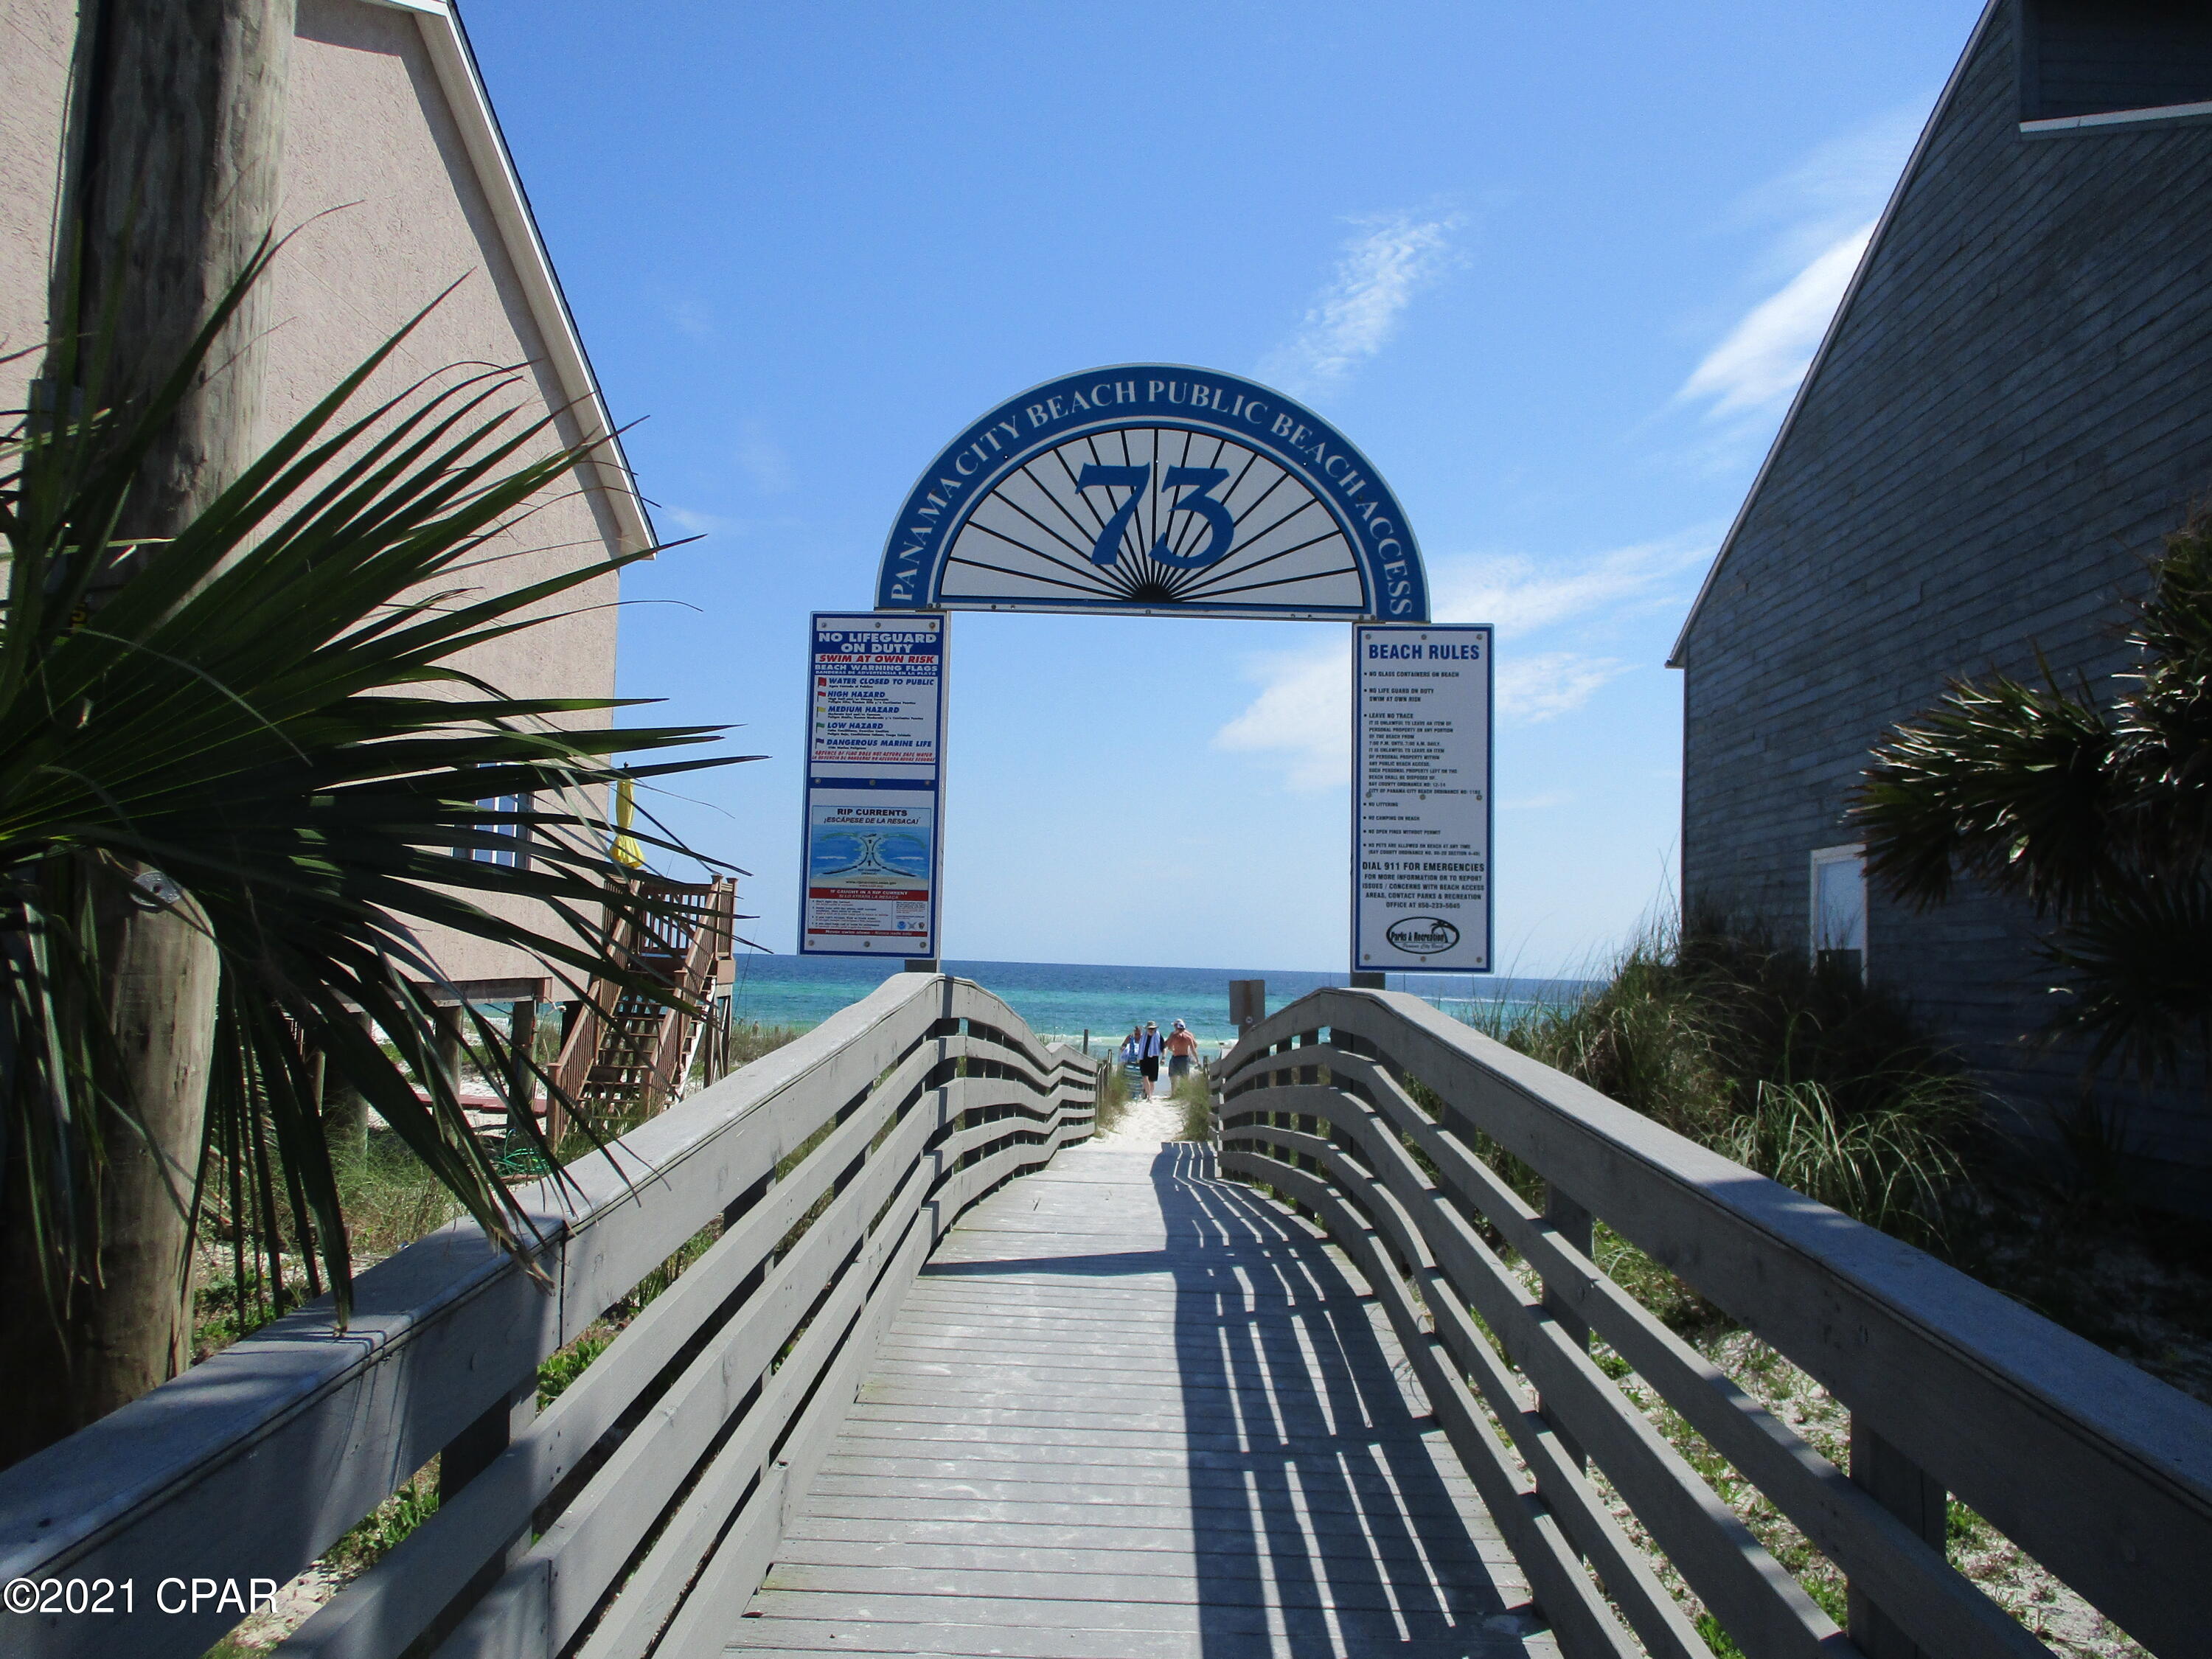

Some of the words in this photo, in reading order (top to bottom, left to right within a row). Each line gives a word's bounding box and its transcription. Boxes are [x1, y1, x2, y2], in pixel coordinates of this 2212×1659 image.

[891, 478, 962, 602] PANAMA
[955, 415, 1020, 476] CITY
[1026, 380, 1136, 428] BEACH
[1148, 380, 1269, 424] PUBLIC
[1270, 413, 1366, 497] BEACH
[1355, 501, 1412, 615] ACCESS
[1074, 461, 1234, 569] 73
[818, 633, 843, 642] NO
[849, 633, 936, 644] LIFEGUARD
[841, 643, 865, 653] ON
[872, 643, 913, 653] DUTY
[1368, 644, 1422, 659] BEACH
[1429, 644, 1480, 660] RULES
[819, 655, 852, 663] SWIM
[856, 655, 871, 663] AT
[874, 655, 904, 663] OWN
[908, 655, 935, 664] RISK
[827, 739, 877, 747] DANGEROUS
[855, 809, 908, 817] CURRENTS
[1363, 861, 1381, 870] DIAL
[1384, 862, 1399, 871] 911
[1403, 862, 1420, 871] FOR
[1423, 863, 1484, 872] EMERGENCIES
[1391, 932, 1407, 941] Parks
[1414, 932, 1444, 942] Recreation
